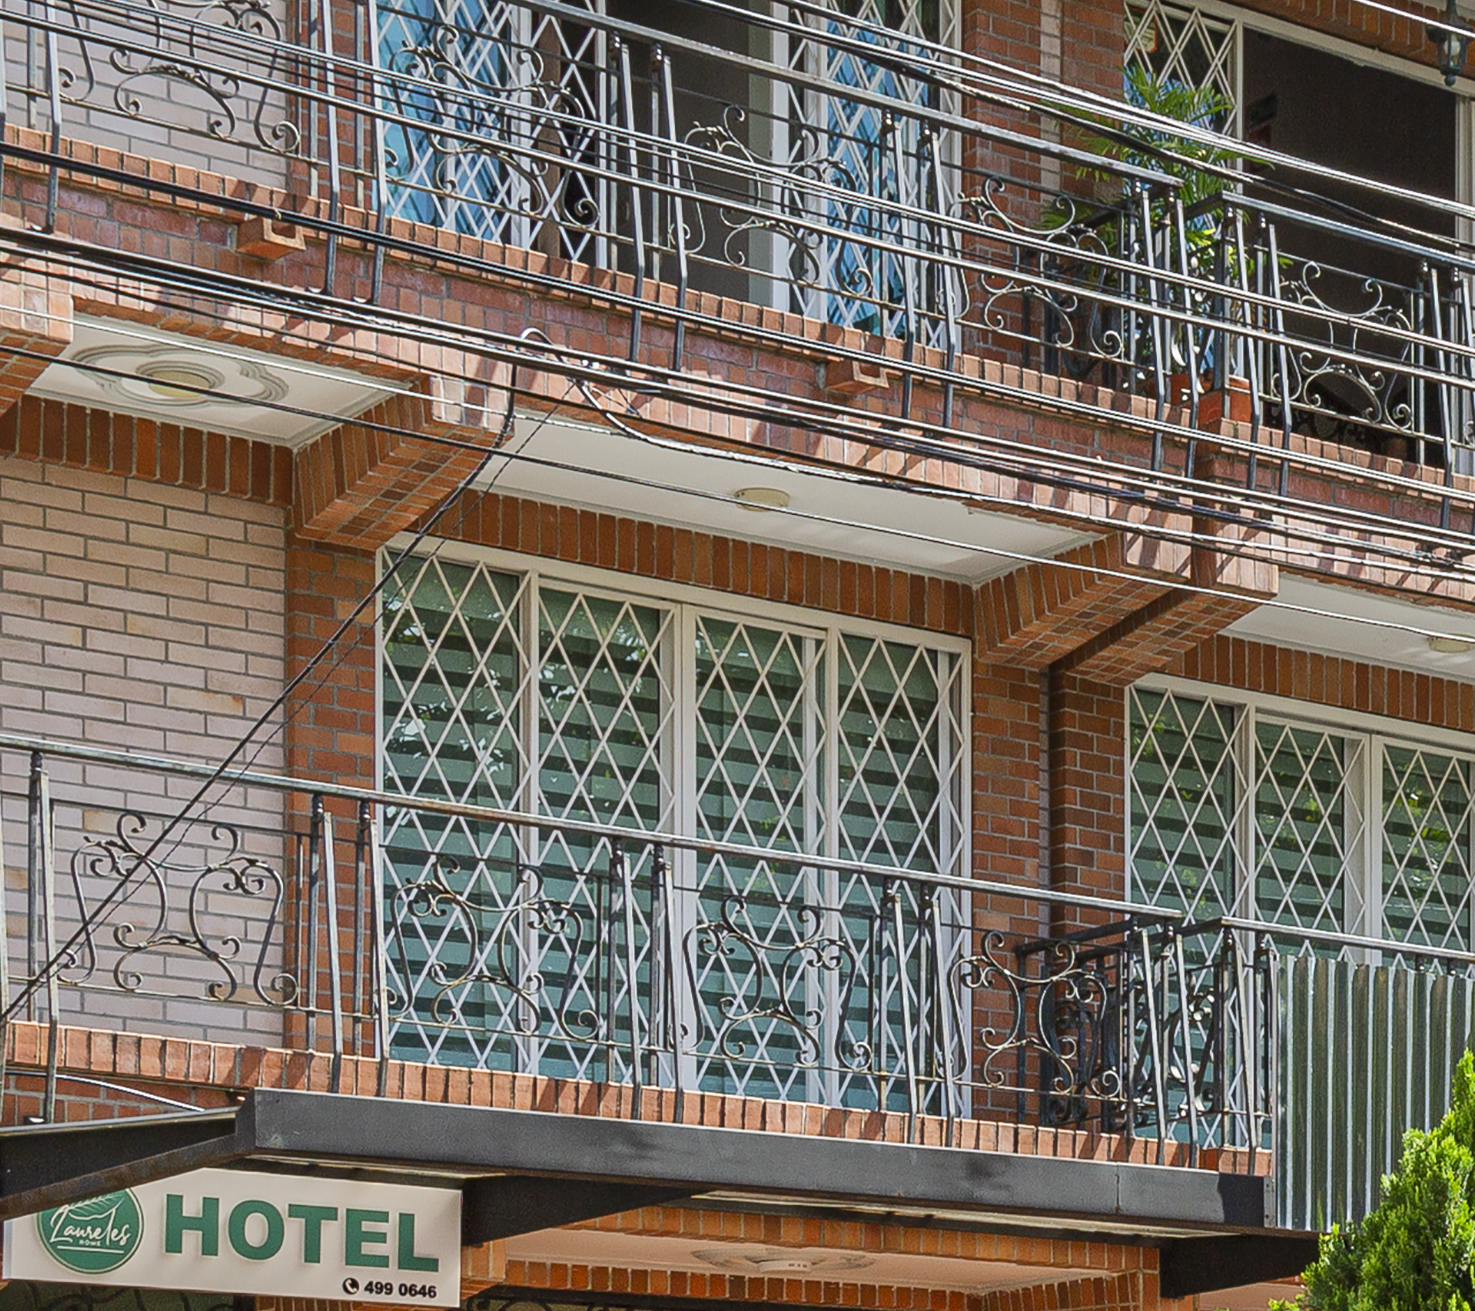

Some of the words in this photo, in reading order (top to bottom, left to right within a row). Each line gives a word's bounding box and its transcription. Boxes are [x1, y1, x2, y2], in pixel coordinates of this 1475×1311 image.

[50, 1204, 131, 1246] Laureles
[165, 1193, 440, 1273] HOTEL
[79, 1239, 102, 1247] HOME
[363, 1280, 394, 1296] 499
[398, 1282, 438, 1299] 0646
